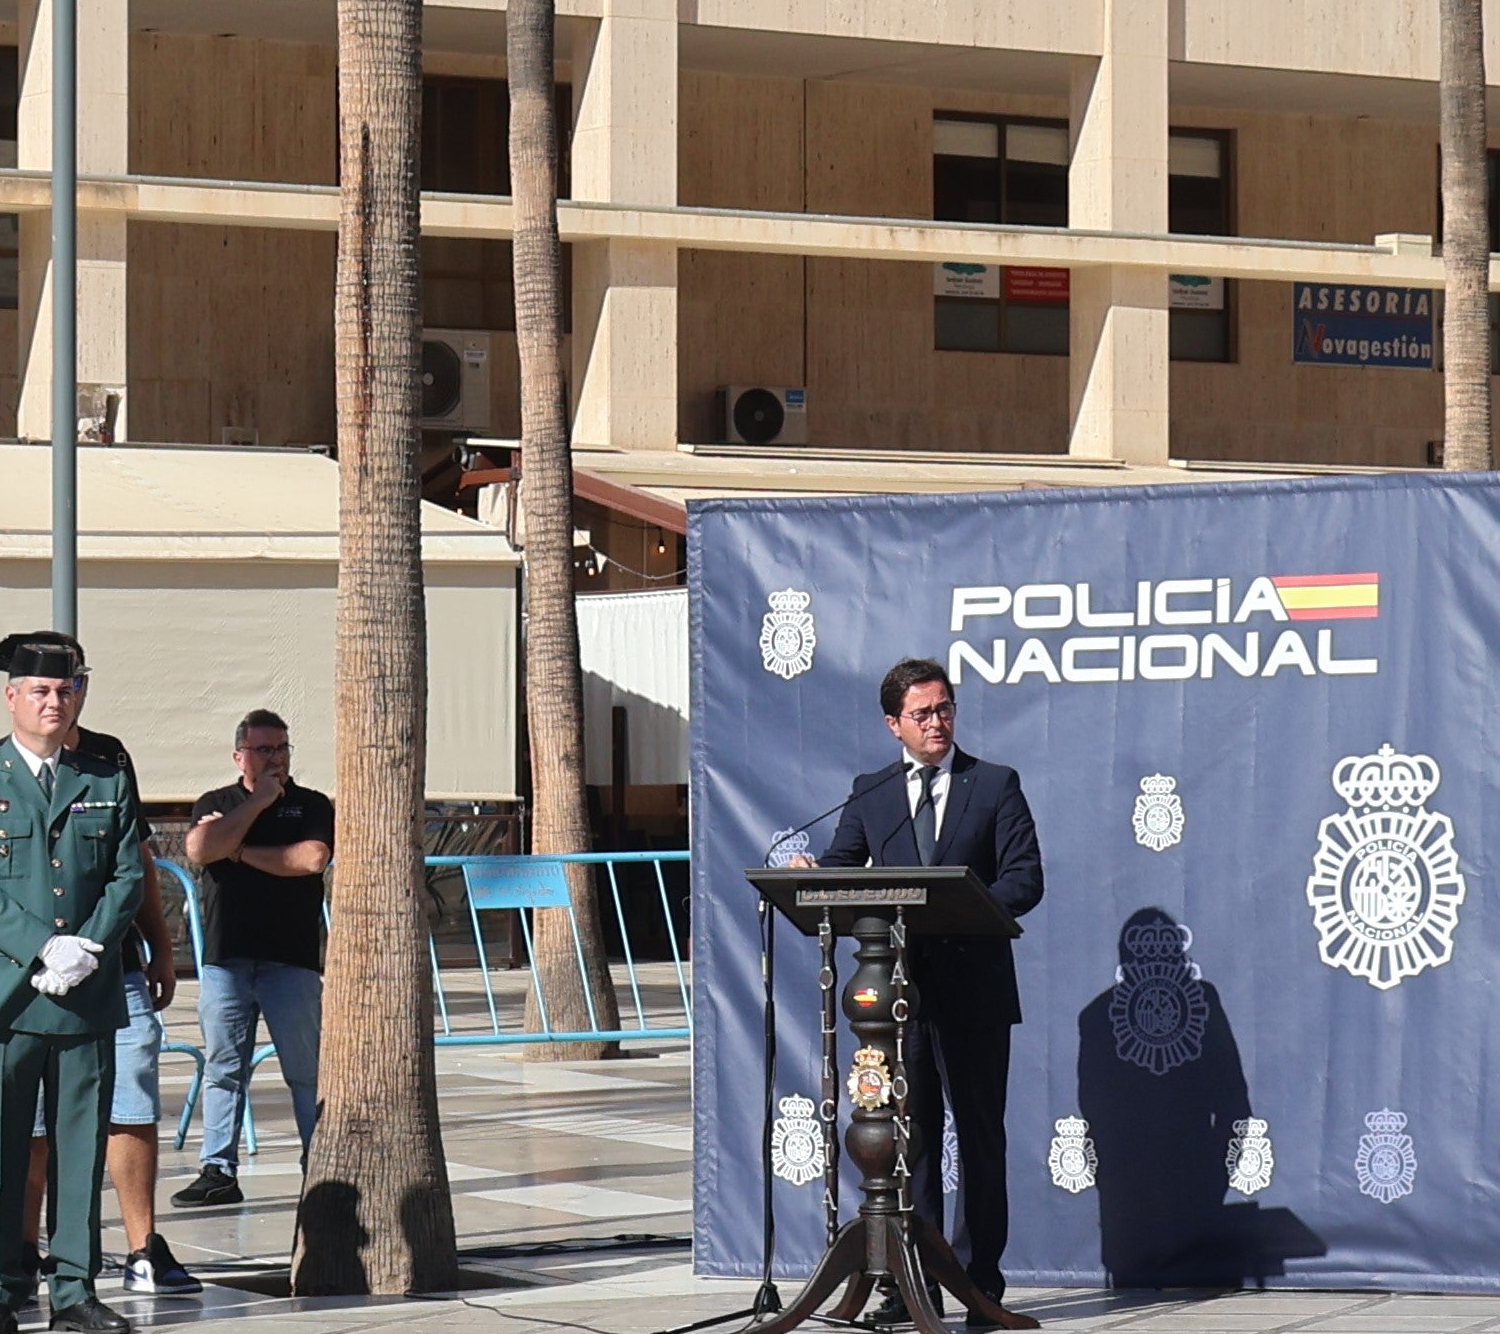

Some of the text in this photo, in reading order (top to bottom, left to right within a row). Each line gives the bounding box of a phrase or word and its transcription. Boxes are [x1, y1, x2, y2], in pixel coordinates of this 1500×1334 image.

[1298, 286, 1430, 316] ASESORÍA
[948, 629, 1379, 685] NACIONAL
[1346, 908, 1424, 940] NACIONAL
[817, 922, 838, 1212] POLICIA
[888, 924, 915, 1212] NACIONAL
